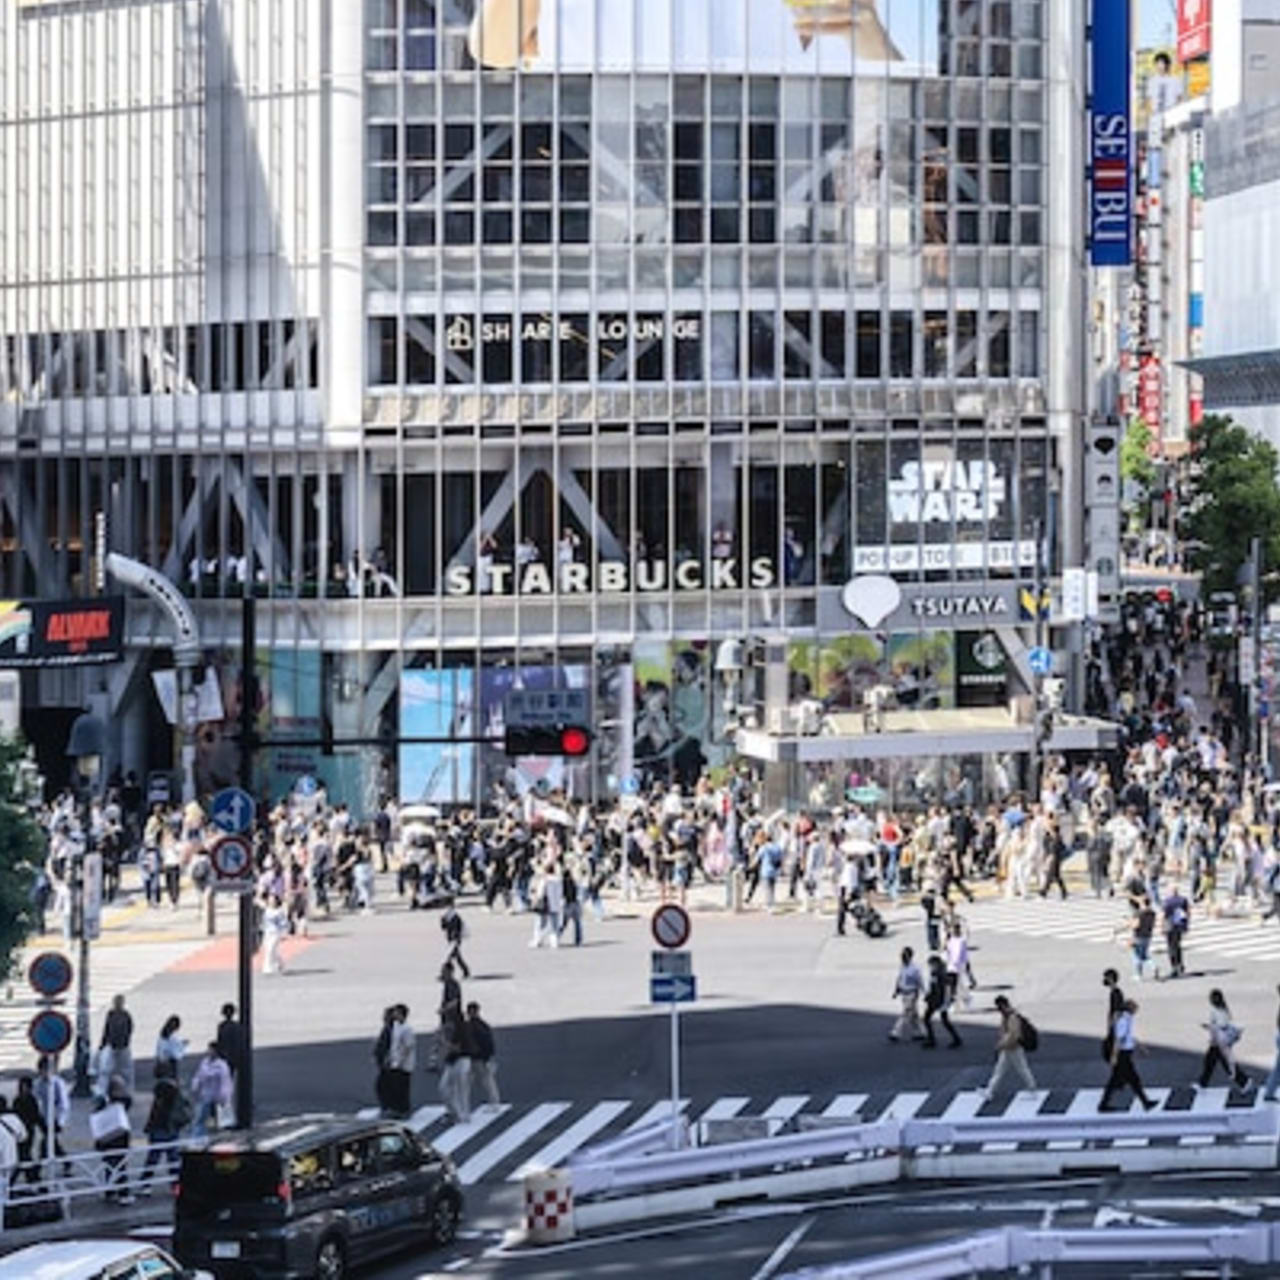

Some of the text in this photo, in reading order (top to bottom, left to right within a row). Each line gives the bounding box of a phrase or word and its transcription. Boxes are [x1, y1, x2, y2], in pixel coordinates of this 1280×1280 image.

[1094, 114, 1127, 241] SEIBU
[482, 321, 698, 340] SHARE LOUNGE
[889, 459, 1006, 490] STAR
[889, 490, 1006, 523] WARS
[858, 550, 914, 568] PO-UP
[447, 557, 774, 596] STARBUCKS
[912, 597, 1008, 616] TSUTAYA
